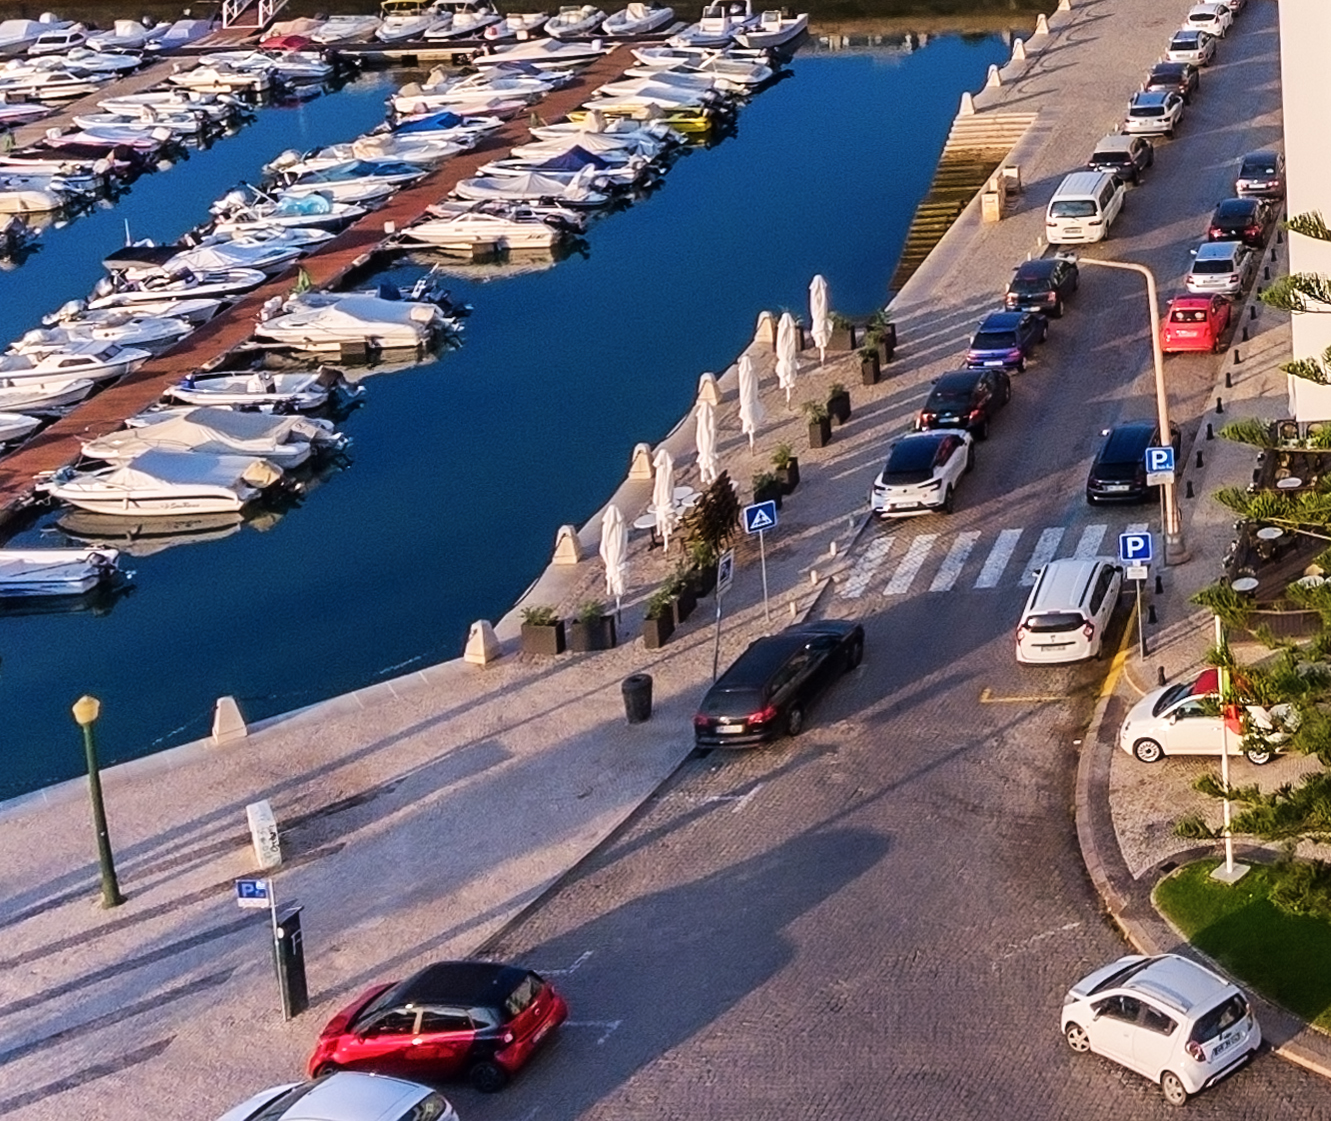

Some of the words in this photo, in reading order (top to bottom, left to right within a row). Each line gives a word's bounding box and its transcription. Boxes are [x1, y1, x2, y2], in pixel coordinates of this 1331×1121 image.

[1151, 450, 1168, 471] P
[1126, 536, 1145, 558] P
[241, 883, 255, 897] P
